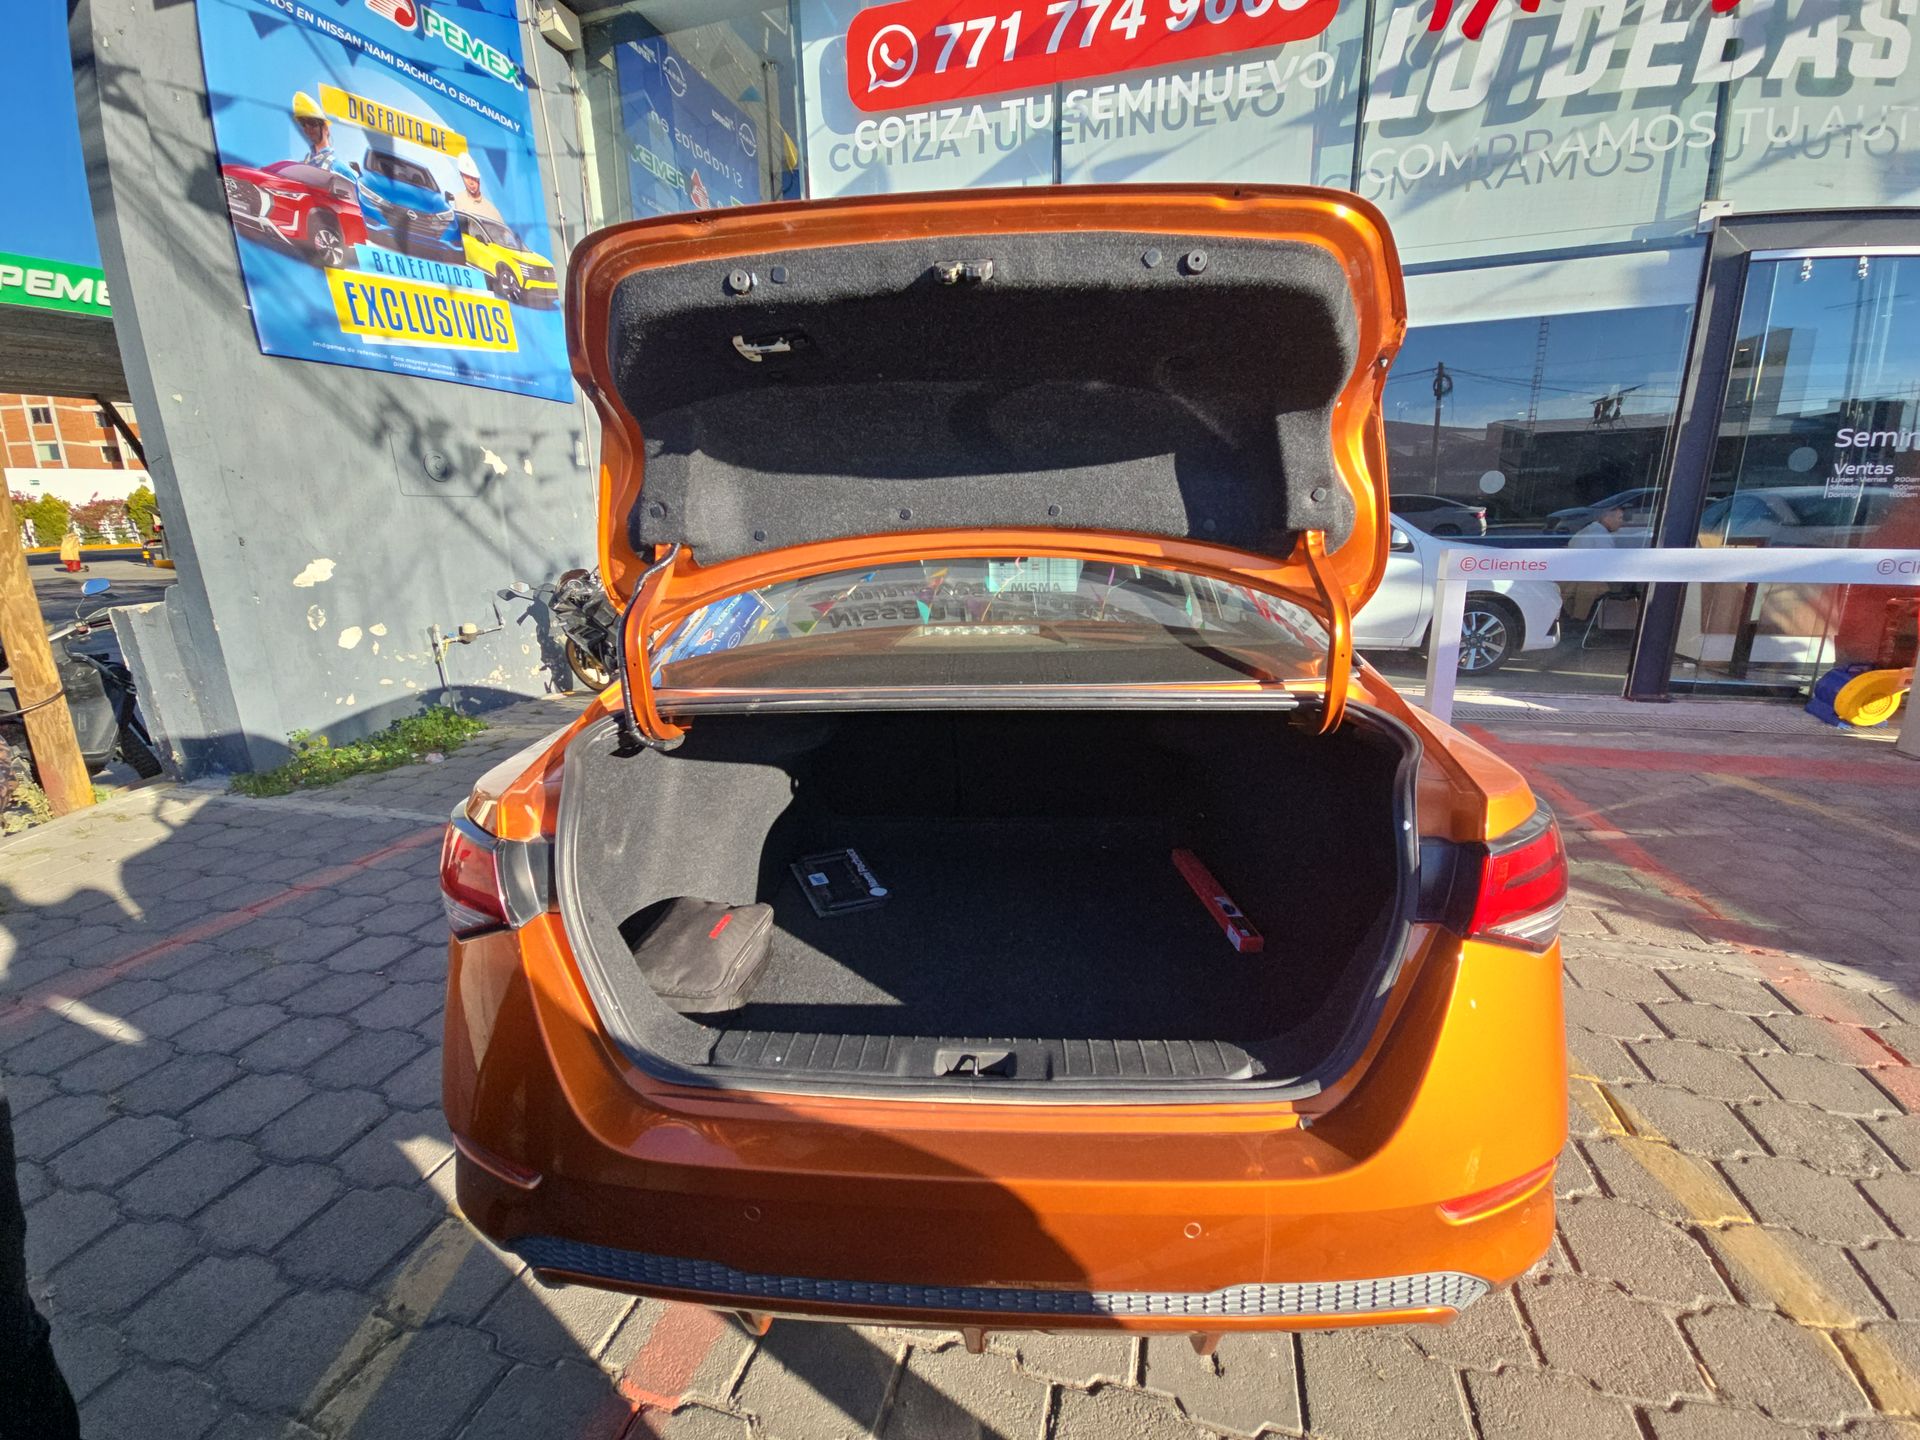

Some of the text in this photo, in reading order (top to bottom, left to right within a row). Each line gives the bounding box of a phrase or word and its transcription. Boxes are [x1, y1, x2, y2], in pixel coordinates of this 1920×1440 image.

[296, 7, 314, 24] EN
[317, 17, 362, 48] NISSAN
[364, 40, 394, 67] NAMI
[396, 60, 447, 95] PACHUCA
[448, 87, 458, 99] O
[459, 92, 514, 130] EXPLANADA
[513, 122, 521, 133] Y
[421, 5, 524, 92] PEMEX
[934, 10, 1022, 74] 771
[1046, 0, 1147, 54] 774
[1363, 0, 1917, 123] LO DEBAS
[348, 96, 446, 151] DISFRUTA DE
[855, 51, 1336, 150] COTIZA TU SEMINUEVO
[1366, 105, 1920, 182] COMPRAMOS TU AUT
[371, 251, 473, 289] BENEFICIOS
[343, 281, 509, 344] EXCLUSIVOS
[1834, 462, 1894, 475] Ventas
[1479, 558, 1548, 571] Clientes
